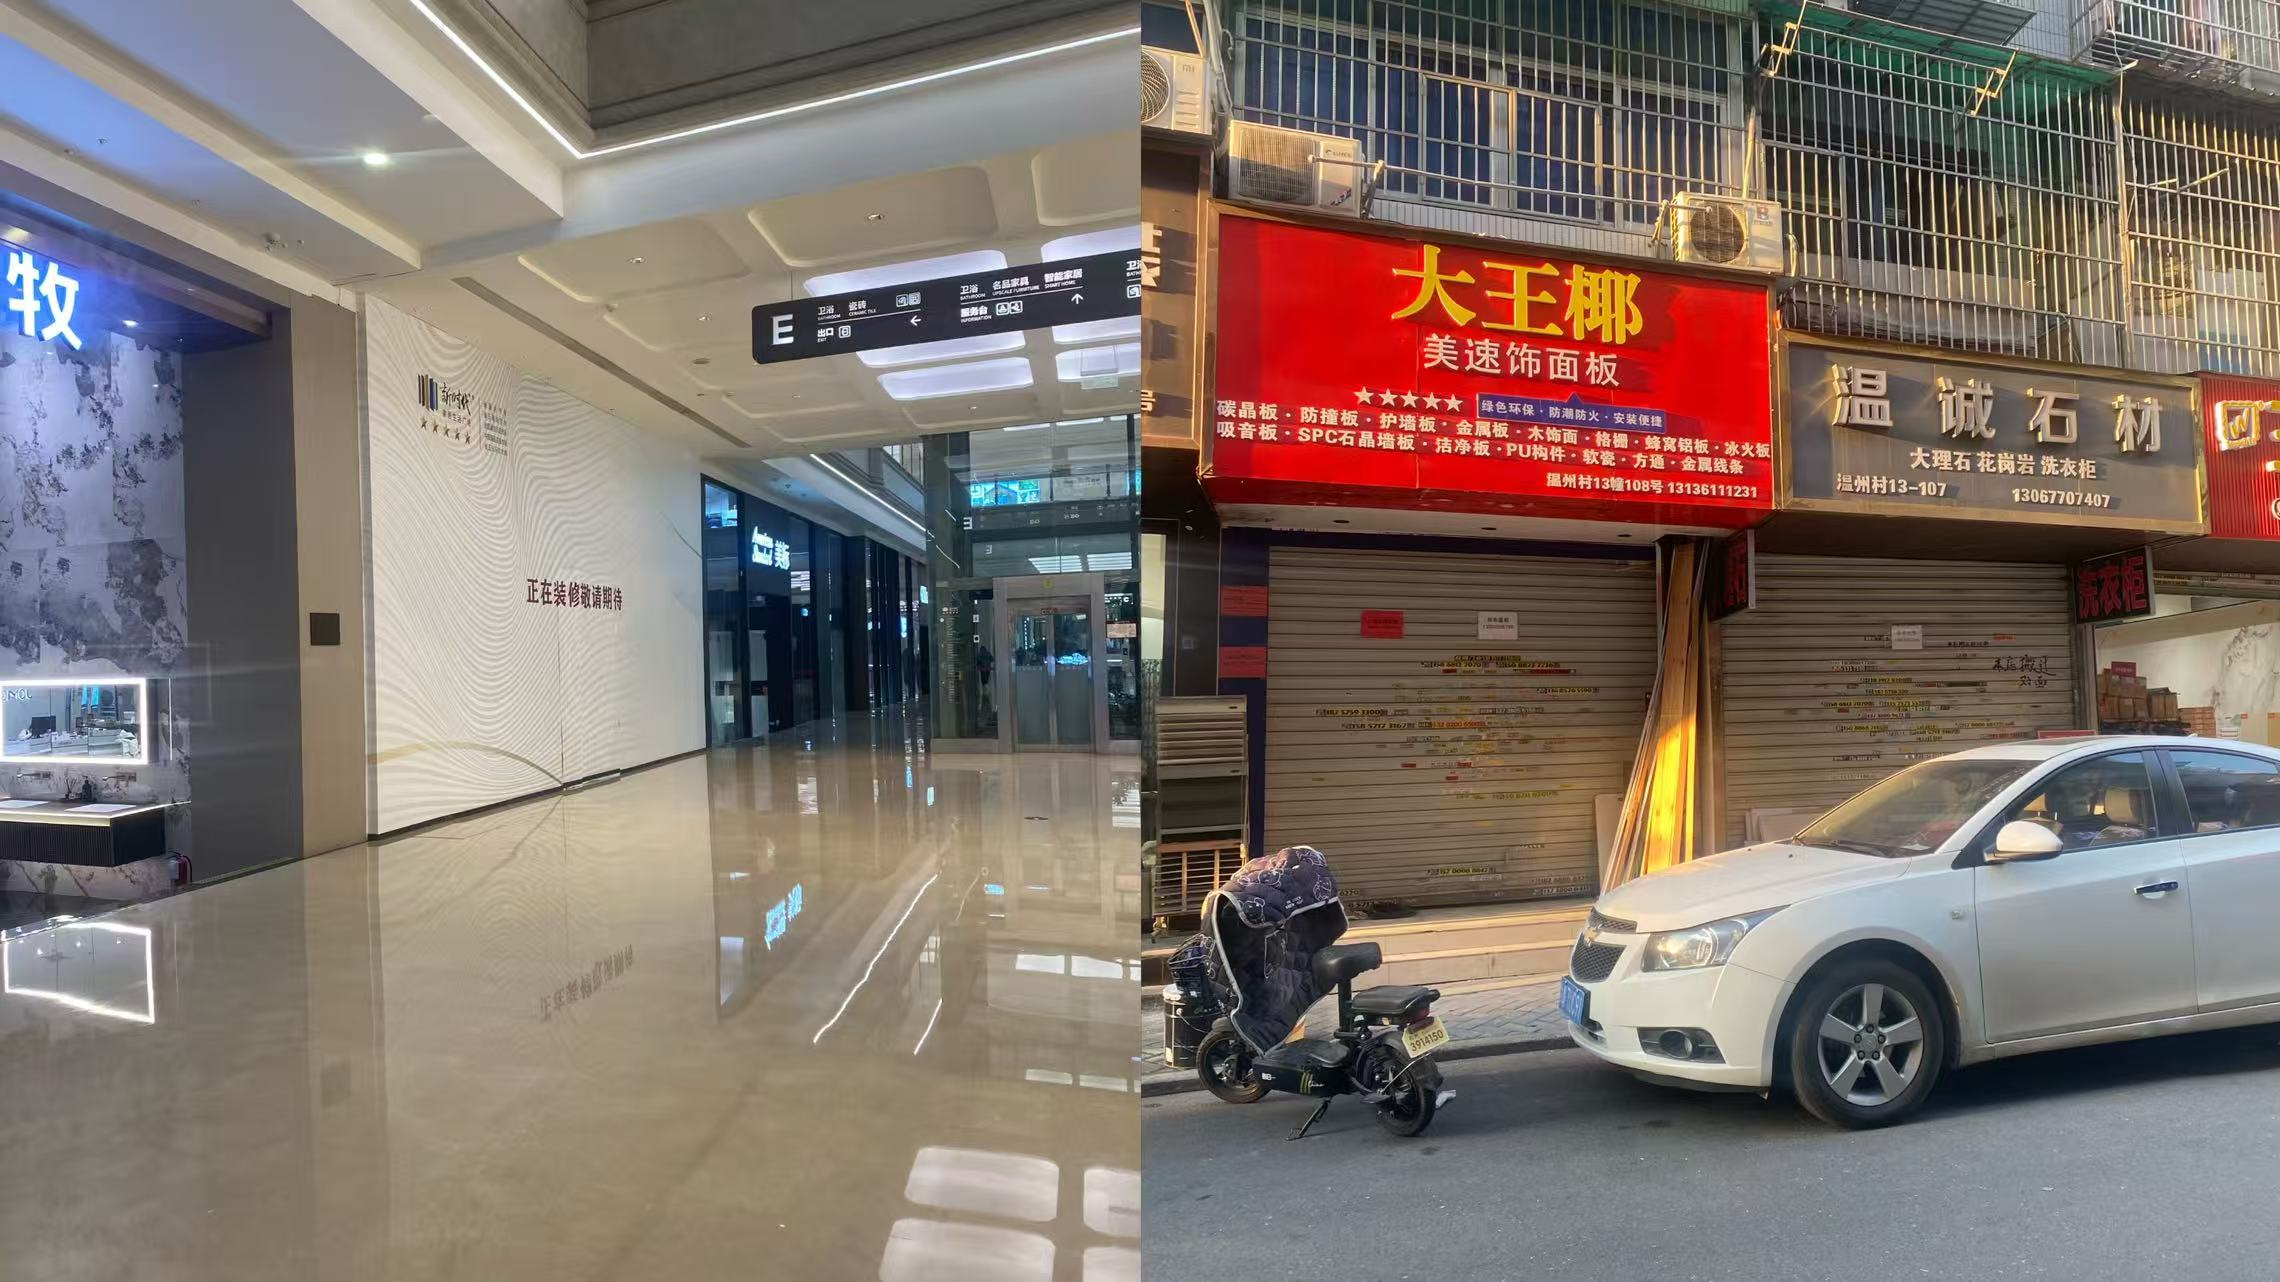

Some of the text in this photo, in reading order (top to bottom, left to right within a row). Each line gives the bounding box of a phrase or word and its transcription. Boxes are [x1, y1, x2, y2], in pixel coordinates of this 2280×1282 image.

[992, 276, 1029, 290] 名品家具
[1044, 268, 1083, 283] 智能家居
[6, 251, 83, 351] 牧
[960, 284, 979, 295] 卫浴
[1391, 244, 1643, 345] 大王椰
[818, 305, 834, 316] 卫浴
[848, 300, 867, 311] 瓷砖
[960, 305, 988, 318] 服务台
[772, 314, 794, 345] E
[817, 327, 834, 338] 出口
[1423, 332, 1620, 387] 美速饰面板
[1832, 363, 2163, 453] 温诚石材
[1910, 447, 2097, 479] 大理石 花岗岩 洗衣柜
[1546, 472, 1758, 499] 温州村13幢108号 13136111231
[2012, 487, 2111, 509] 13067707407
[527, 579, 622, 611] 正在装修敬请期待
[1410, 1029, 1444, 1052] 3914150
